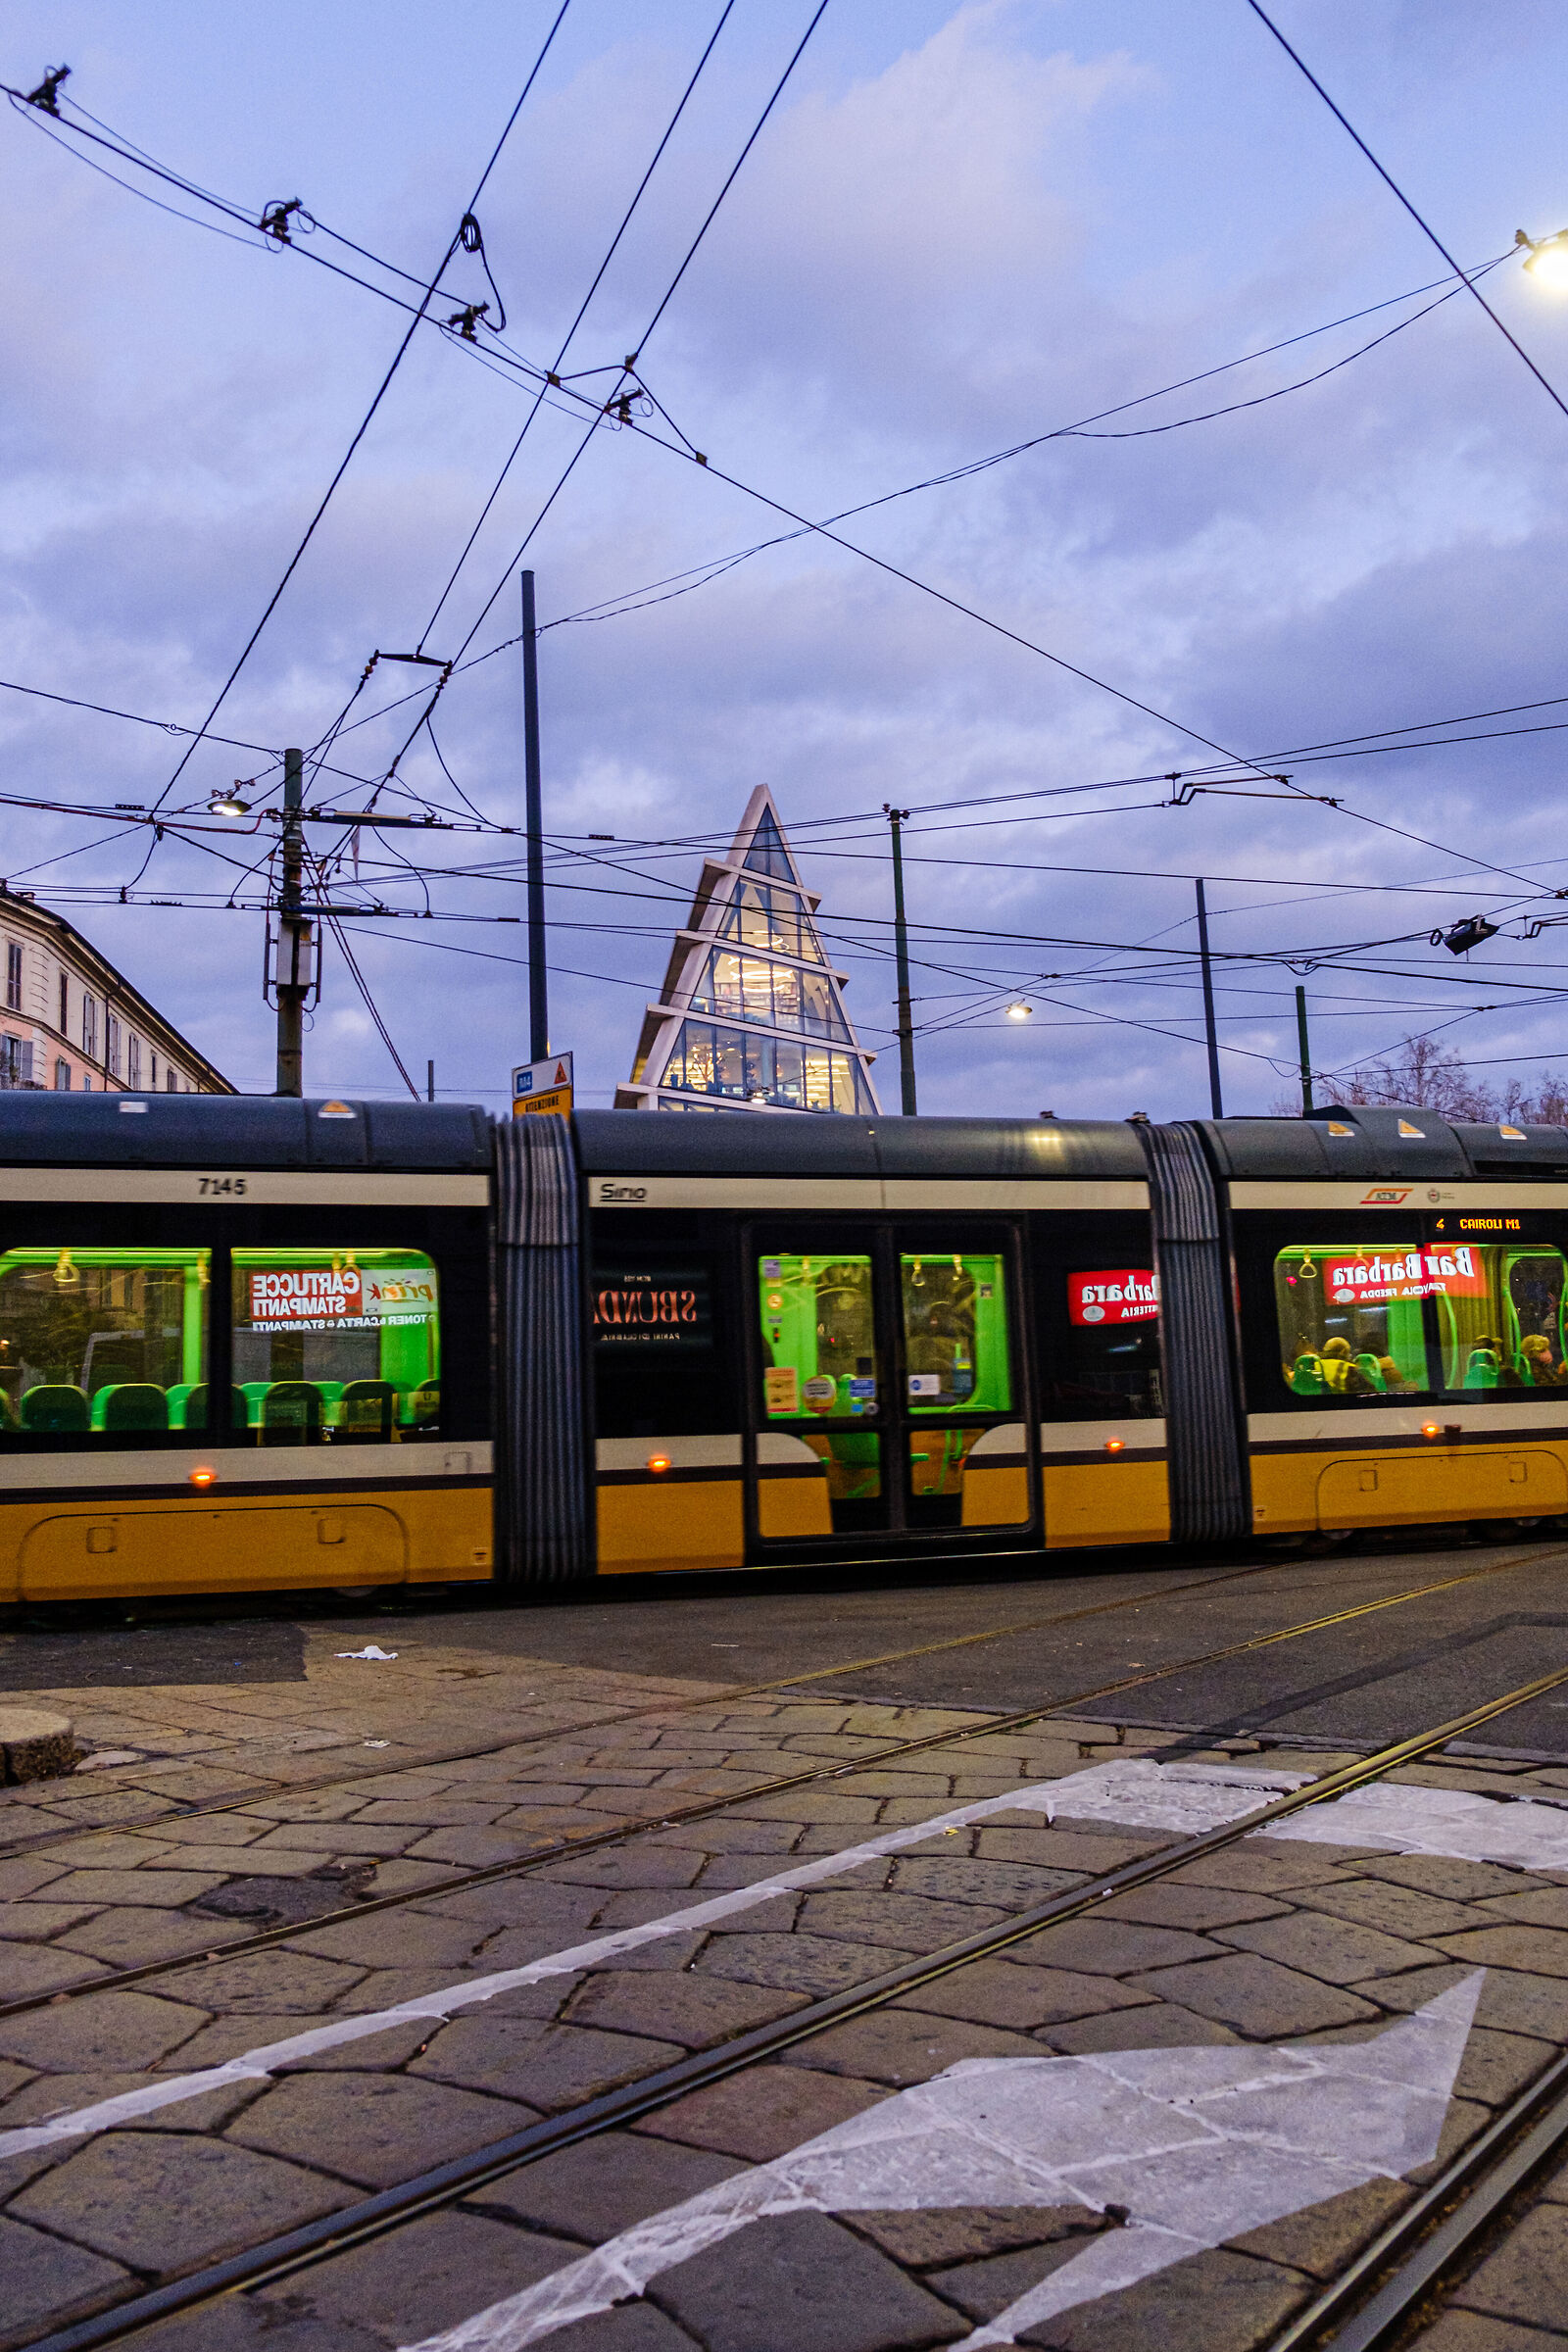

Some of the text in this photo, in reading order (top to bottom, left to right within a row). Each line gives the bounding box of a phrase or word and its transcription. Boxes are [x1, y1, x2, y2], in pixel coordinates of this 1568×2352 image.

[198, 1178, 248, 1195] 7145
[599, 1183, 647, 1200] Sirio
[1459, 1218, 1503, 1230] CAIROLI
[1504, 1218, 1521, 1230] M1
